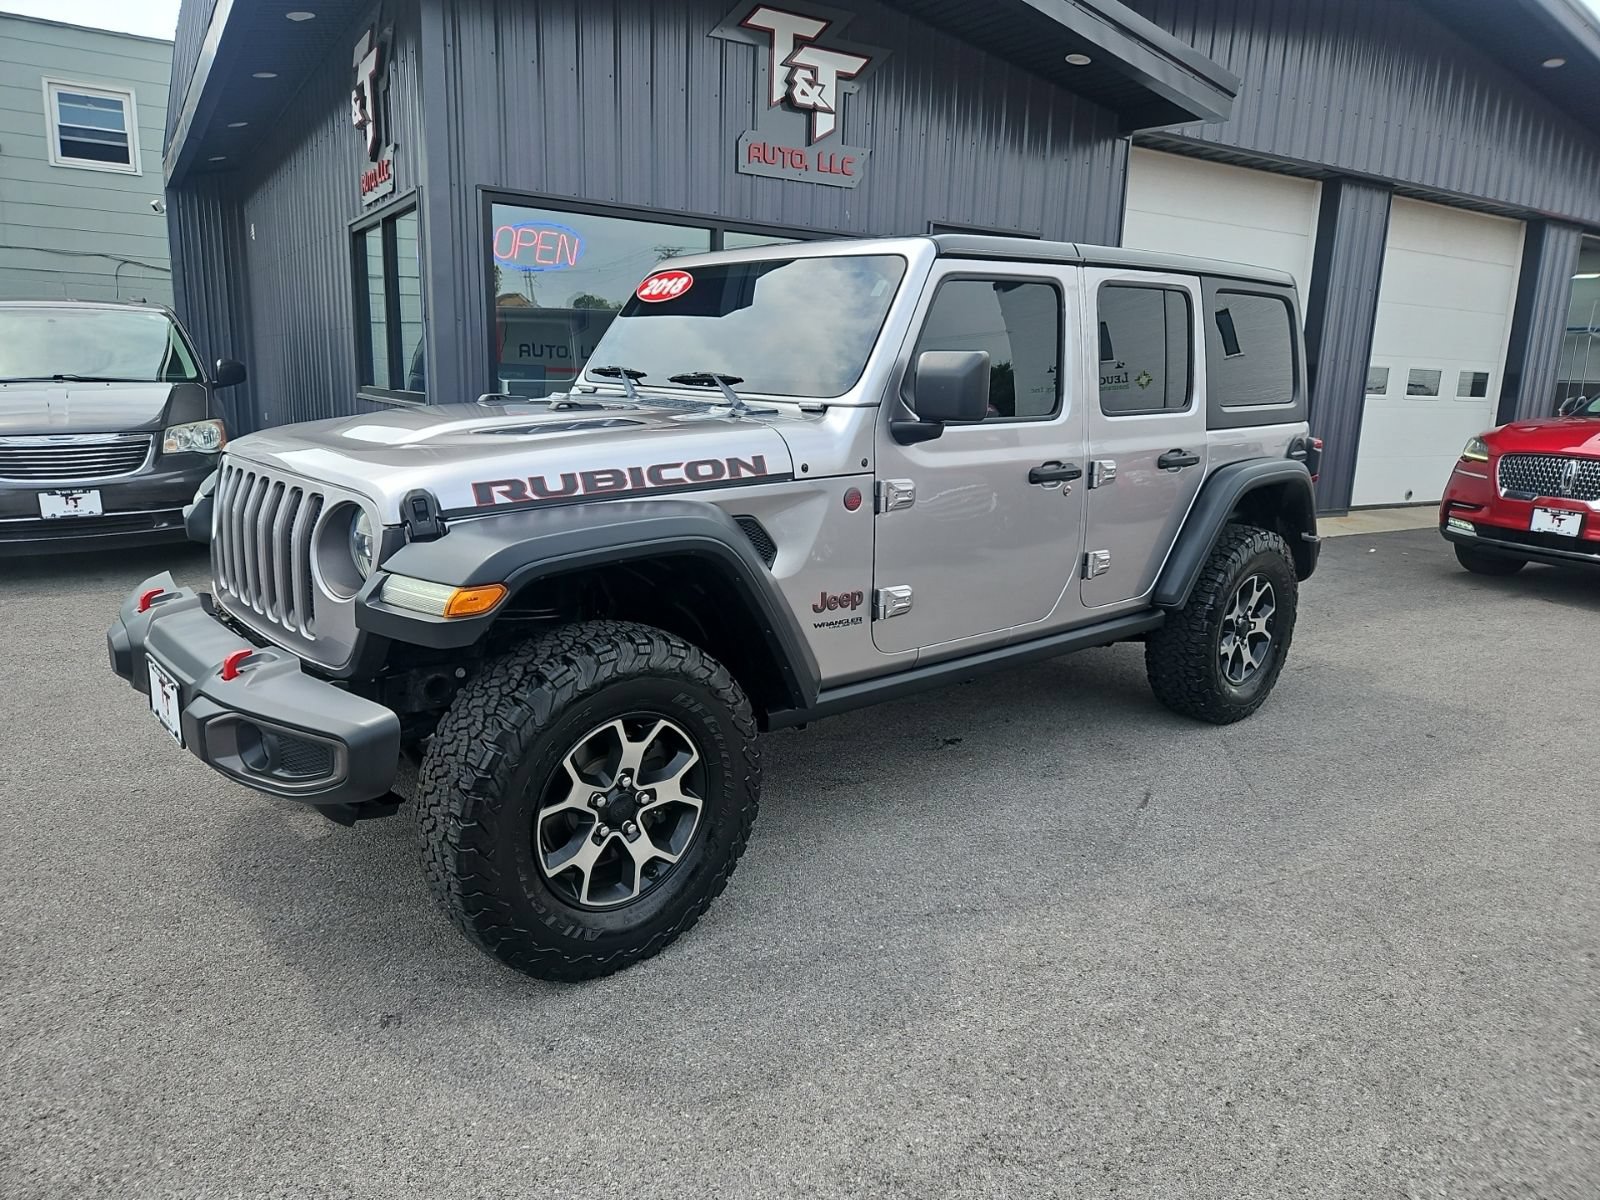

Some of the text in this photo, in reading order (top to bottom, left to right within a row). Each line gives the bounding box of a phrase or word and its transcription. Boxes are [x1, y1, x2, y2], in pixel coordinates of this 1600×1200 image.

[738, 3, 873, 144] T&T
[376, 160, 391, 182] LLC
[817, 151, 857, 176] LLC
[493, 225, 580, 267] OPEN
[640, 276, 689, 297] 2018
[471, 454, 768, 507] RUBICON
[812, 590, 865, 614] Jeep
[813, 616, 863, 629] WRANGLER
